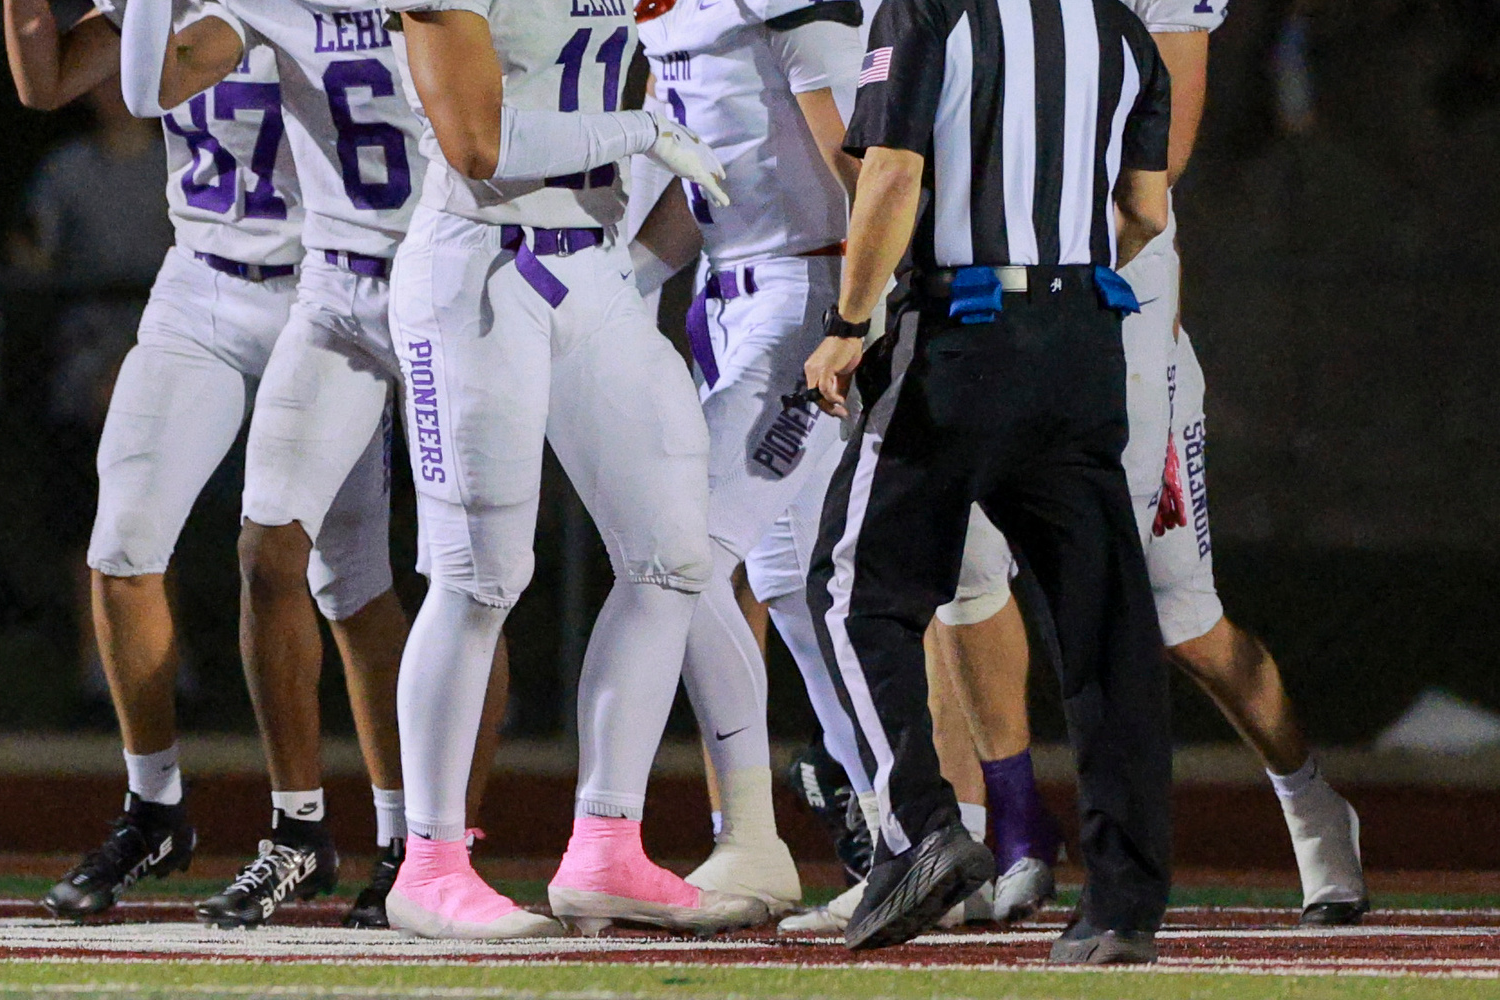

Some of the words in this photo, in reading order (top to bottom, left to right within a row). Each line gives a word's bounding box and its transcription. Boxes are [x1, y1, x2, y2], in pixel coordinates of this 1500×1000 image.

[161, 81, 288, 220] 87
[322, 58, 412, 210] 6
[545, 26, 629, 189] 11
[408, 339, 446, 484] PIONEERS
[800, 762, 826, 808] NIKE
[259, 852, 317, 919] BATTLE
